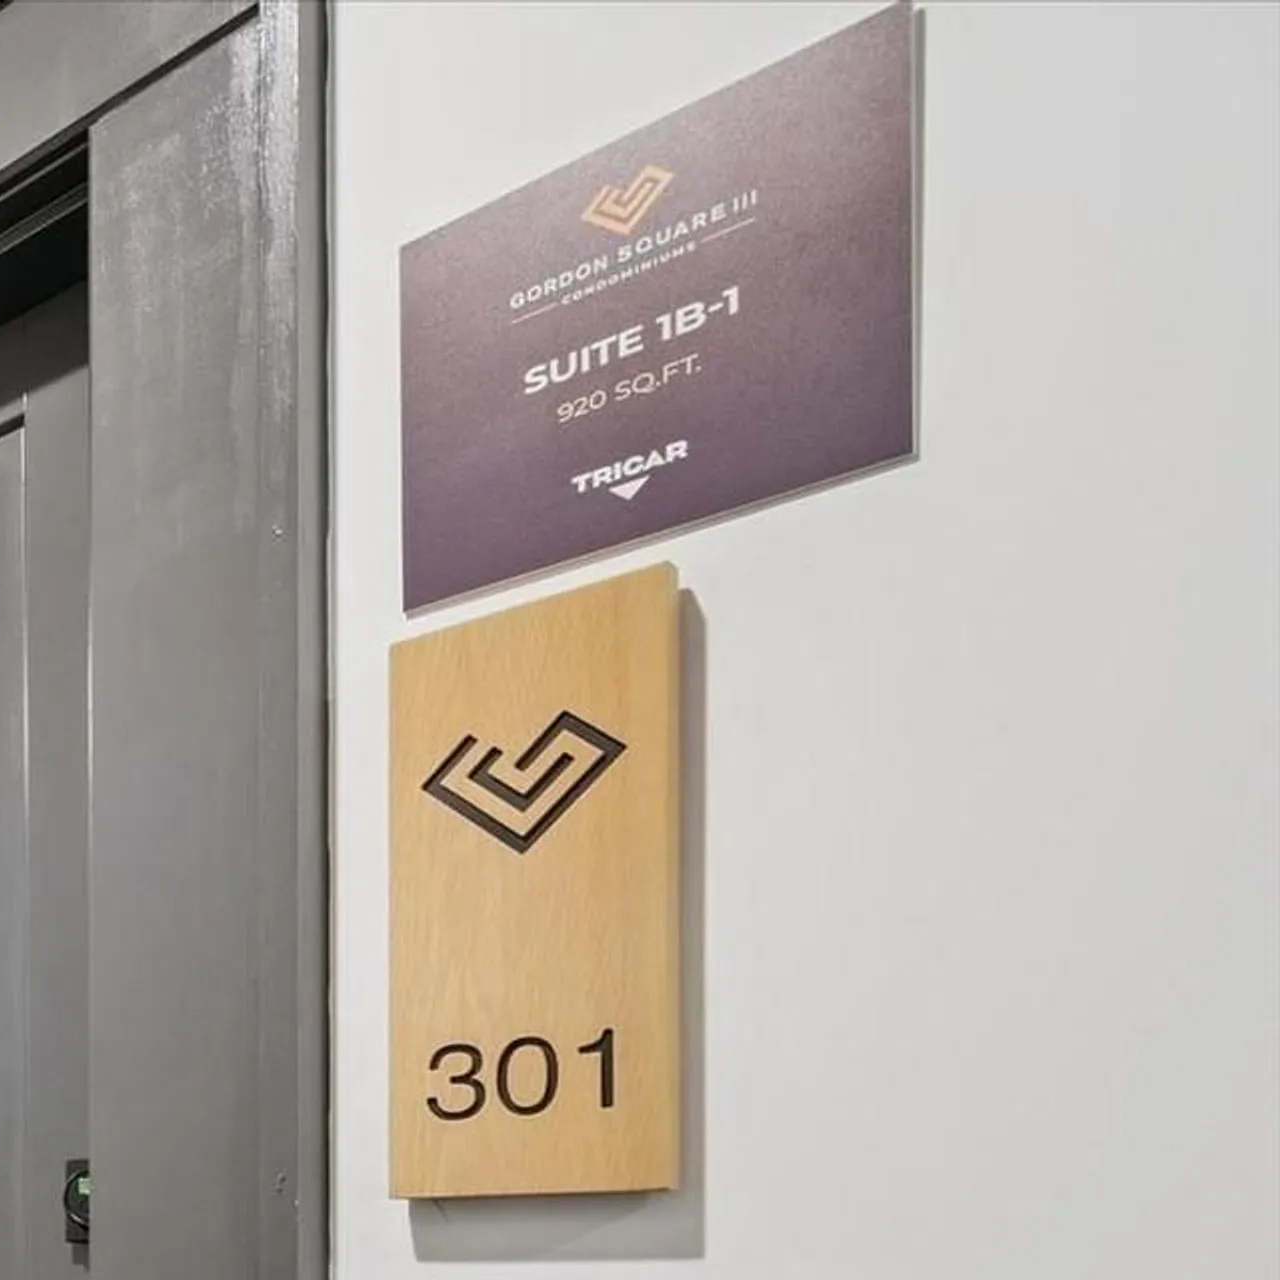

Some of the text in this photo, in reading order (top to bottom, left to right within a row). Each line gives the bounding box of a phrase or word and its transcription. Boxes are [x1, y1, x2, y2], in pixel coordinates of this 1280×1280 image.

[509, 254, 609, 309] GORDON
[616, 202, 728, 263] SQUARE
[560, 241, 697, 305] CONDOMINIUMS
[523, 285, 740, 395] SUITE 1B-1
[556, 353, 703, 424] 920 SQ.FT.
[570, 439, 689, 494] TRICAR
[425, 1026, 615, 1121] 301
